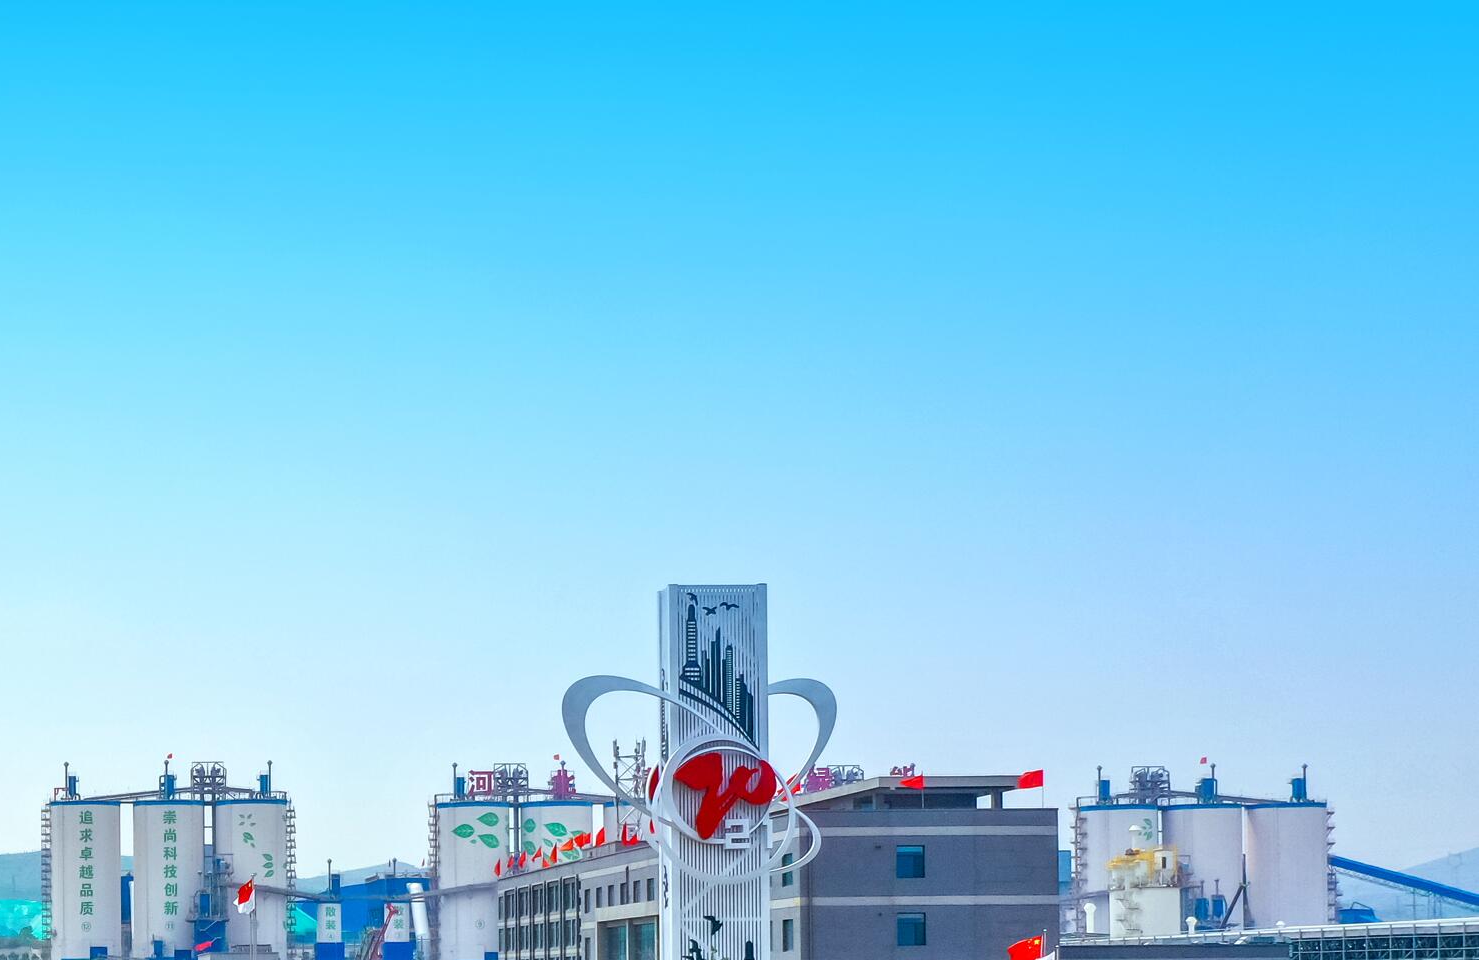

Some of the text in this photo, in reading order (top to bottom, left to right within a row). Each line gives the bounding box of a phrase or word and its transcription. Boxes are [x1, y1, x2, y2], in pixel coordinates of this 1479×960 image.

[79, 810, 94, 916] 追求卓越品质
[163, 810, 178, 916] 崇尚科技创新
